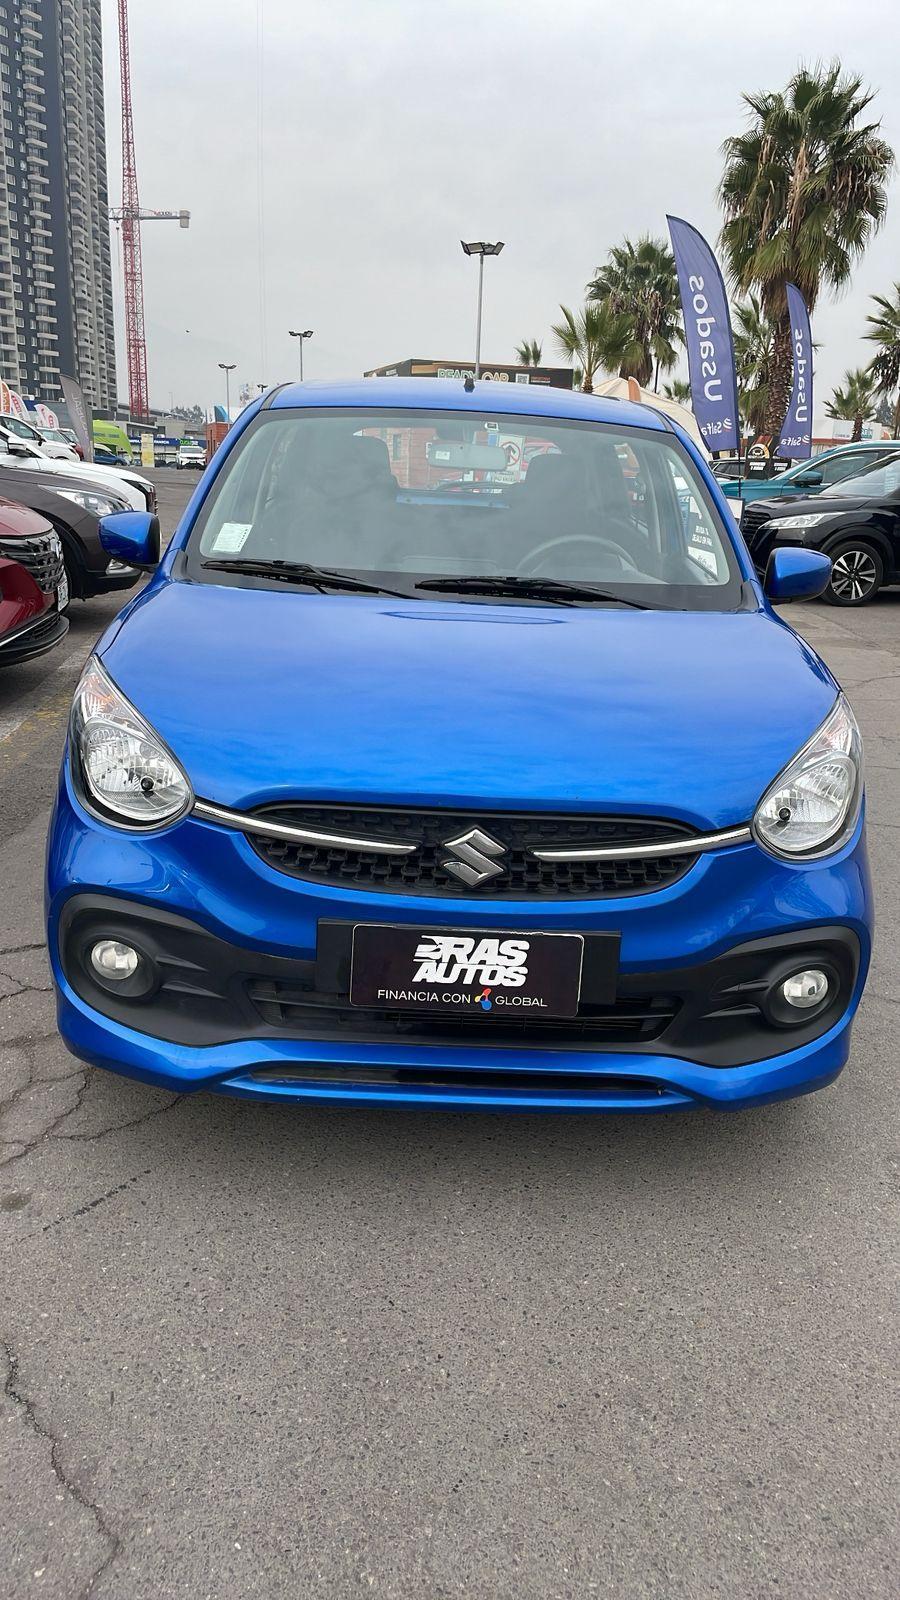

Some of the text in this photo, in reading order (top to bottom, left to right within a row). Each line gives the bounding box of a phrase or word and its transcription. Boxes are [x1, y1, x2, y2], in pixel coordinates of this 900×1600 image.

[412, 962, 529, 987] AUTOS
[377, 989, 548, 1007] FINANCIA CON GLOBAL
